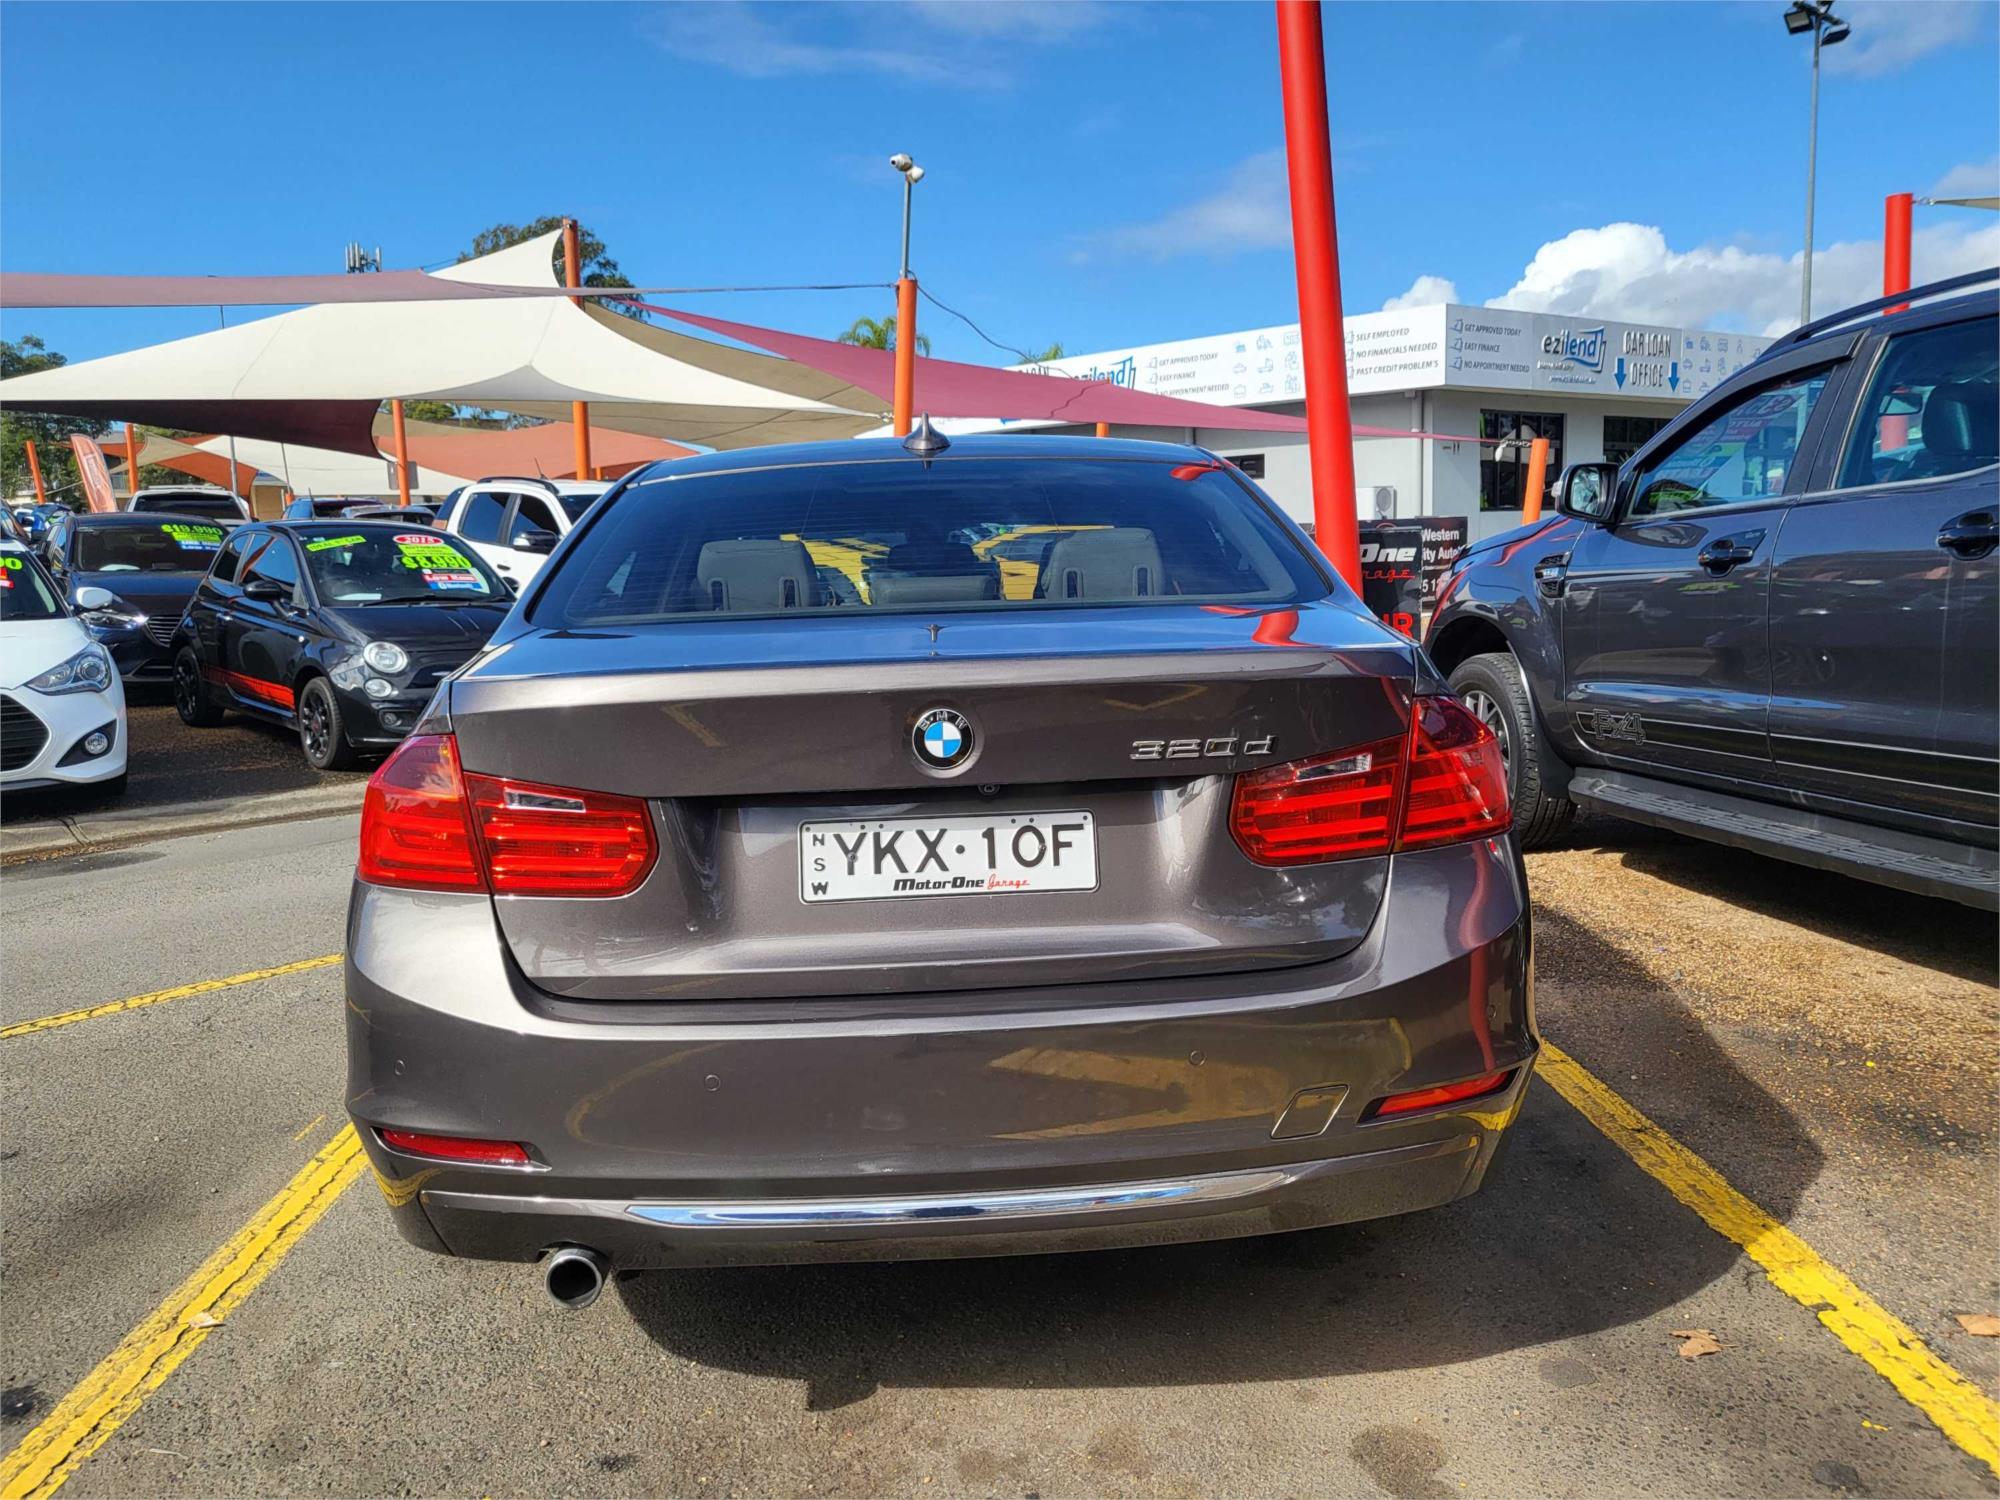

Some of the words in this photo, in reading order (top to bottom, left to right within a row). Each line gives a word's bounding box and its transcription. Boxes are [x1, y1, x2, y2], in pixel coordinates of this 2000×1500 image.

[1356, 332, 1371, 341] SELF
[1372, 328, 1410, 340] EMPLOYED
[1476, 325, 1504, 335] APPROVED
[1504, 328, 1522, 337] TODAY
[1356, 350, 1367, 359] NO
[1367, 344, 1407, 357] FINANCIALS
[1408, 342, 1438, 352] NEEDED
[1464, 342, 1478, 351] EASY
[1542, 329, 1599, 358] ezilend
[1623, 330, 1645, 356] CAR
[1645, 332, 1671, 358] LOAN
[1356, 367, 1372, 376] PAST
[1373, 364, 1398, 374] CREDIT
[1464, 360, 1473, 369] NO
[1473, 361, 1510, 371] APPOINTMENT
[1510, 364, 1530, 373] NEEDED
[1630, 362, 1663, 388] OFFICE
[1421, 528, 1460, 541] Western
[1422, 546, 1436, 563] ity
[1129, 734, 1277, 760] 320d
[893, 876, 984, 891] MotorOne
[987, 873, 1031, 890] Garage
